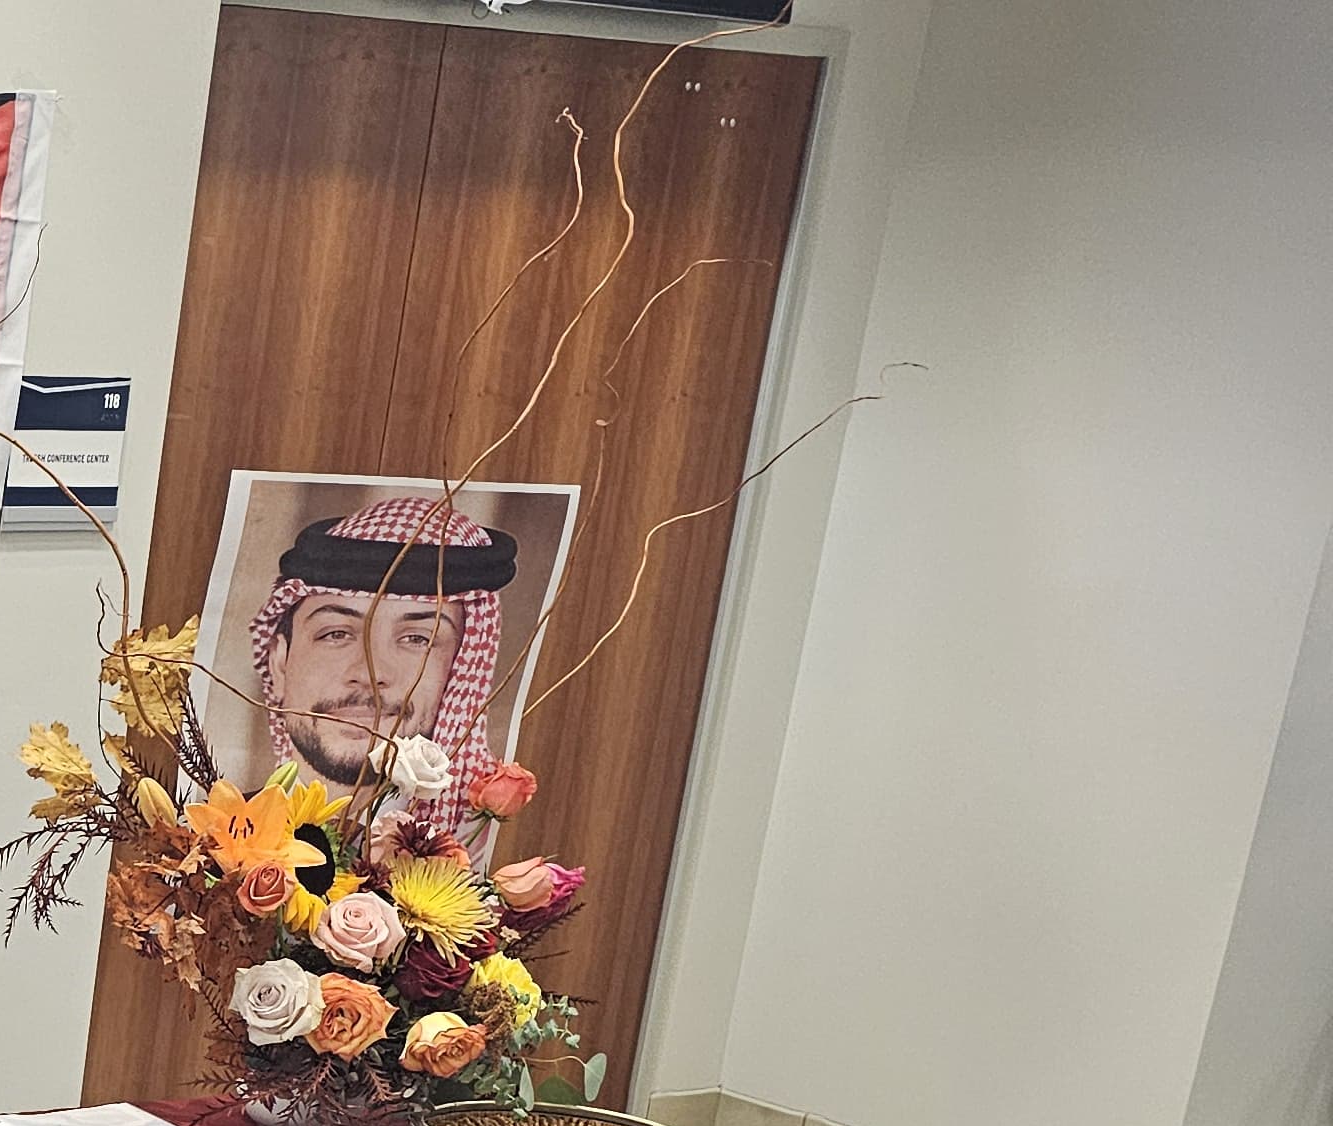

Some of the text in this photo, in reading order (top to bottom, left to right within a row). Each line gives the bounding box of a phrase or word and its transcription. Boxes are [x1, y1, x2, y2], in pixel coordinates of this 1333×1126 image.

[104, 393, 121, 409] 118
[46, 453, 85, 463] CONFERENCE
[87, 454, 110, 463] CENTER
